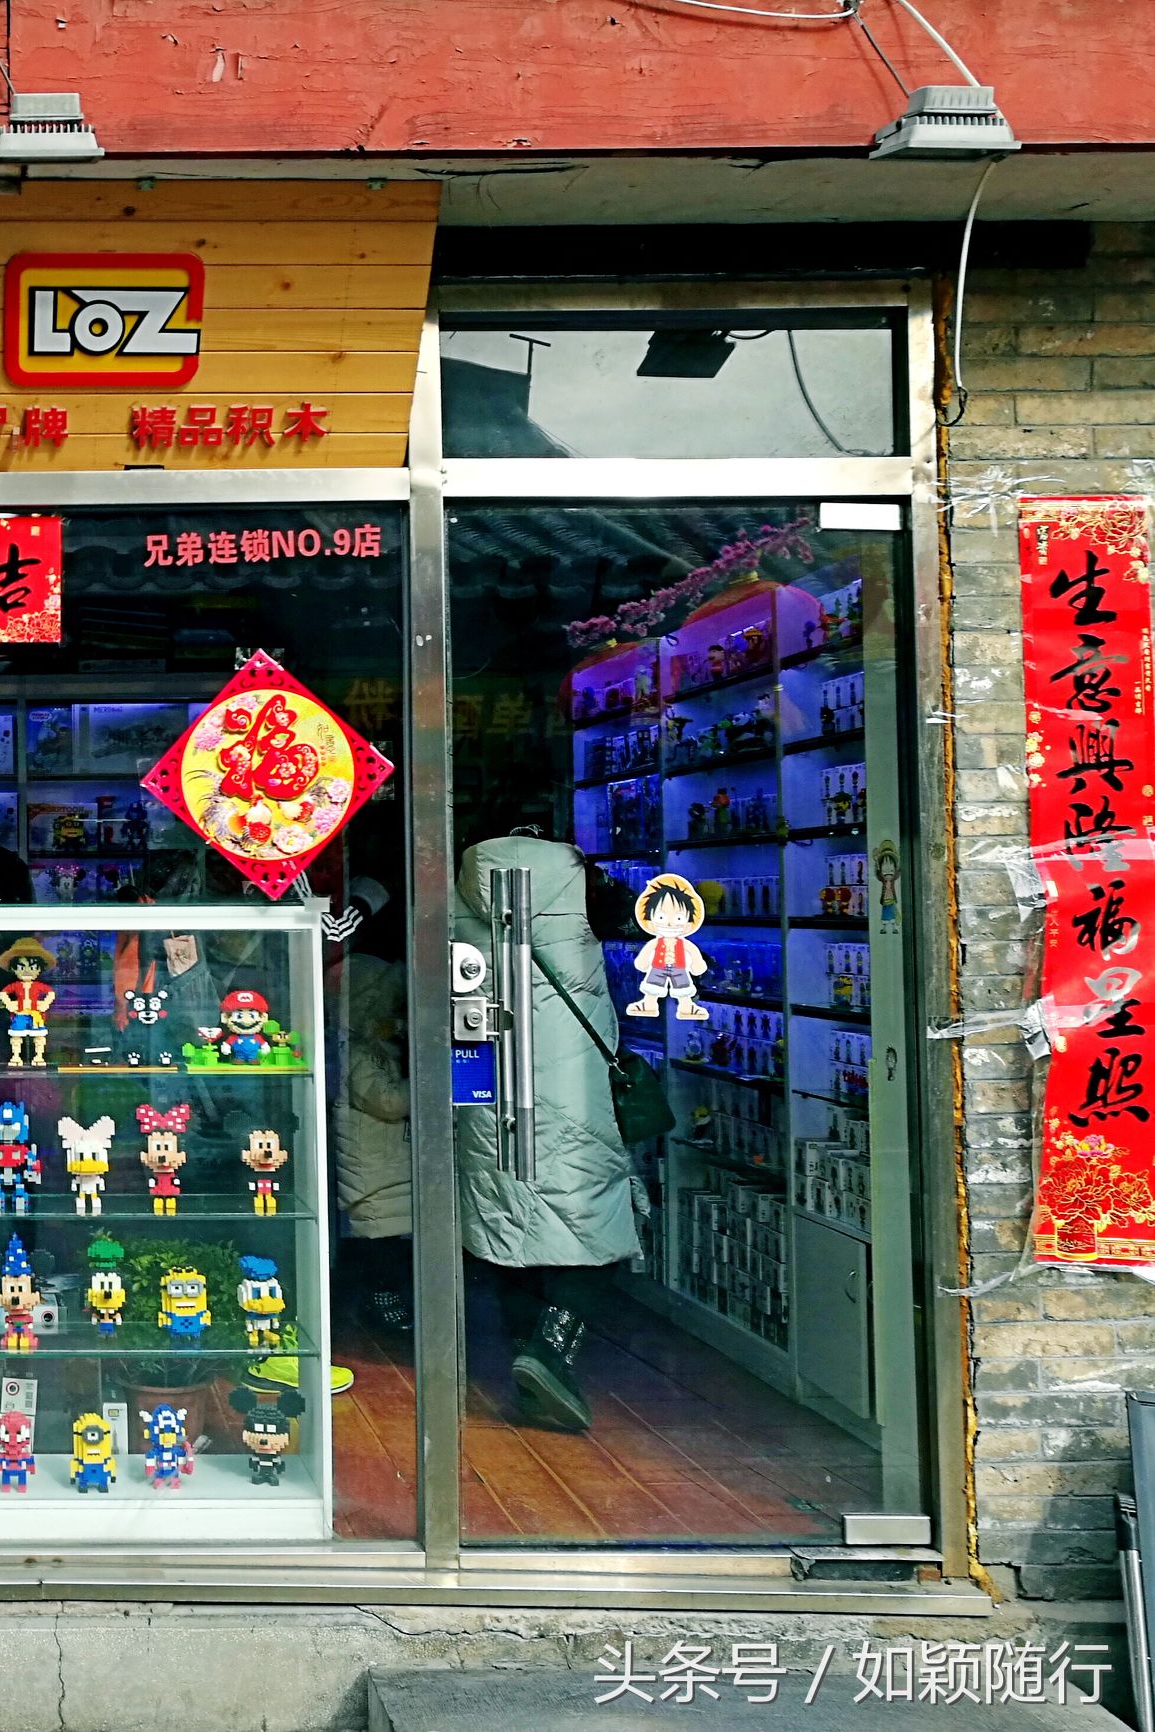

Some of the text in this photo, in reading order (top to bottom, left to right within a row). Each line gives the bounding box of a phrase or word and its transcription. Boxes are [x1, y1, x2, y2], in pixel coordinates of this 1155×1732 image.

[28, 286, 201, 357] LOZ
[131, 402, 330, 448] 精品积木
[455, 1049, 479, 1059] PULL
[472, 1090, 492, 1098] VISA
